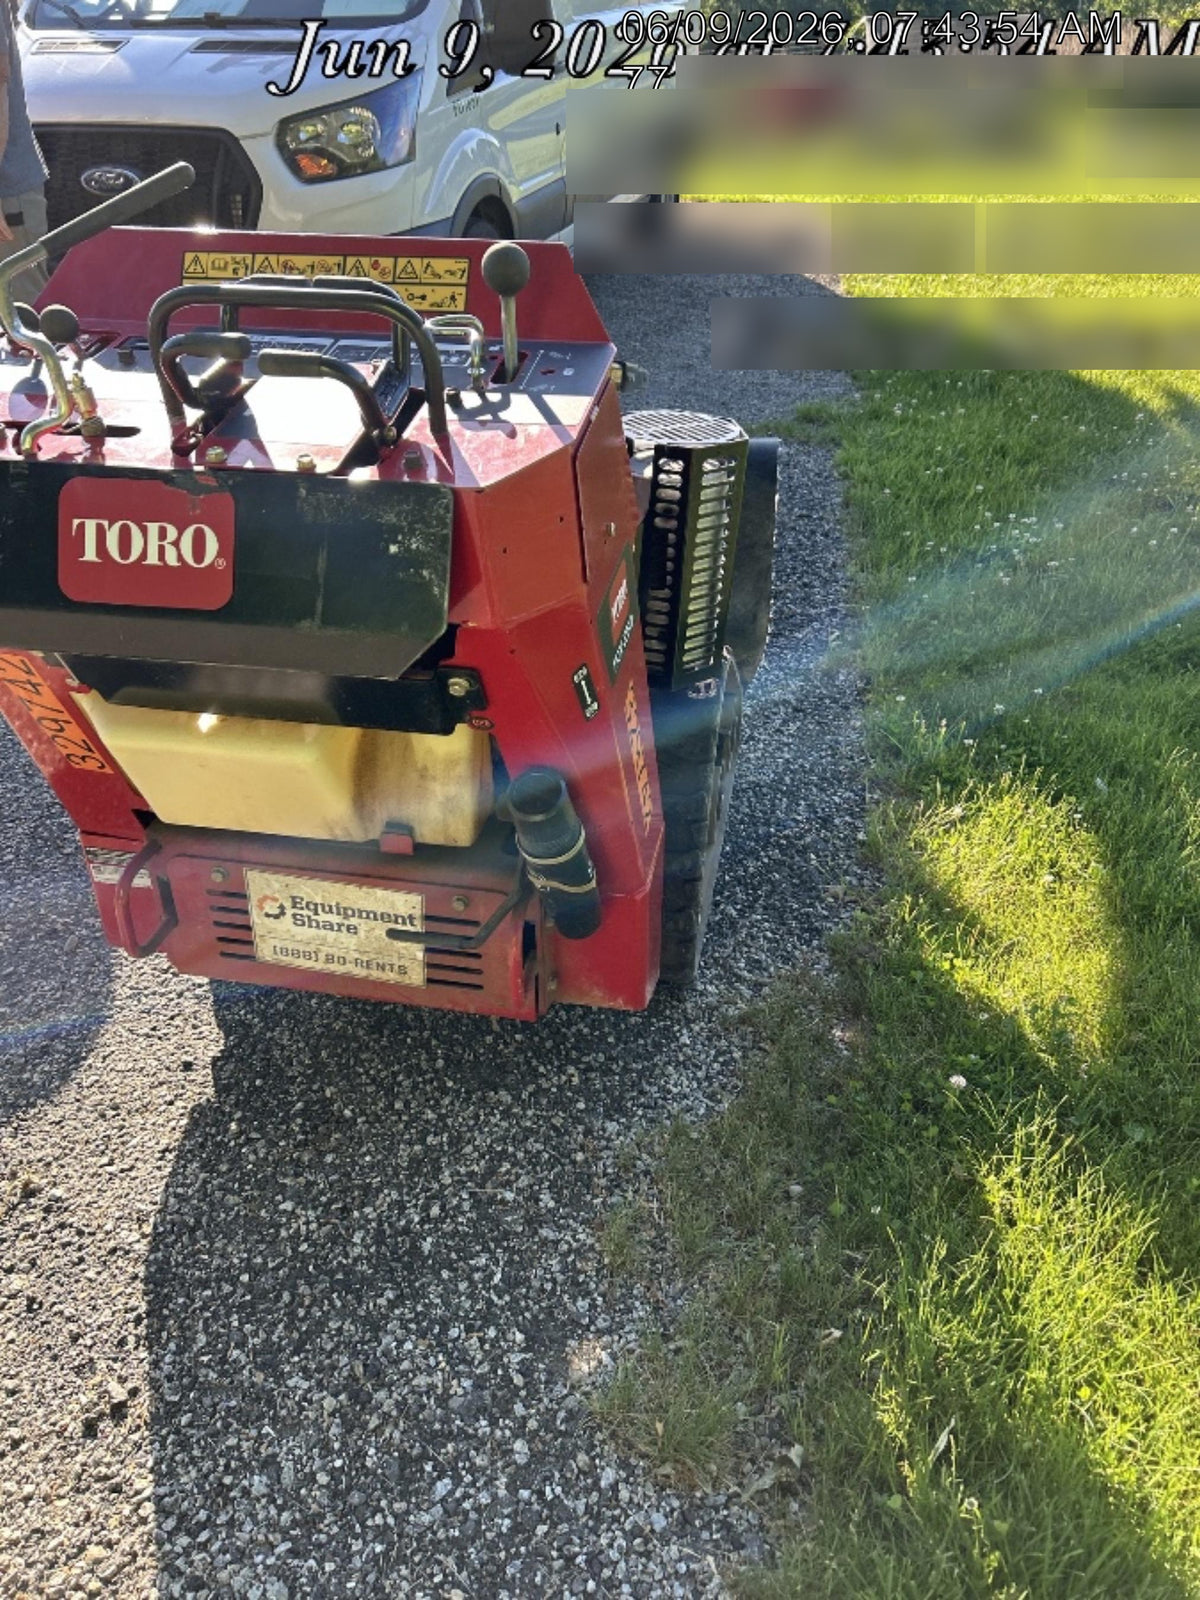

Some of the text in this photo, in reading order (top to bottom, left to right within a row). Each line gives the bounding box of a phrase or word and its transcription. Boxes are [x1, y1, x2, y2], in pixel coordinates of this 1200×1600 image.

[72, 518, 219, 568] TORO
[289, 895, 418, 928] Equipment
[290, 912, 358, 936] Share
[324, 952, 409, 976] 80-RENTS
